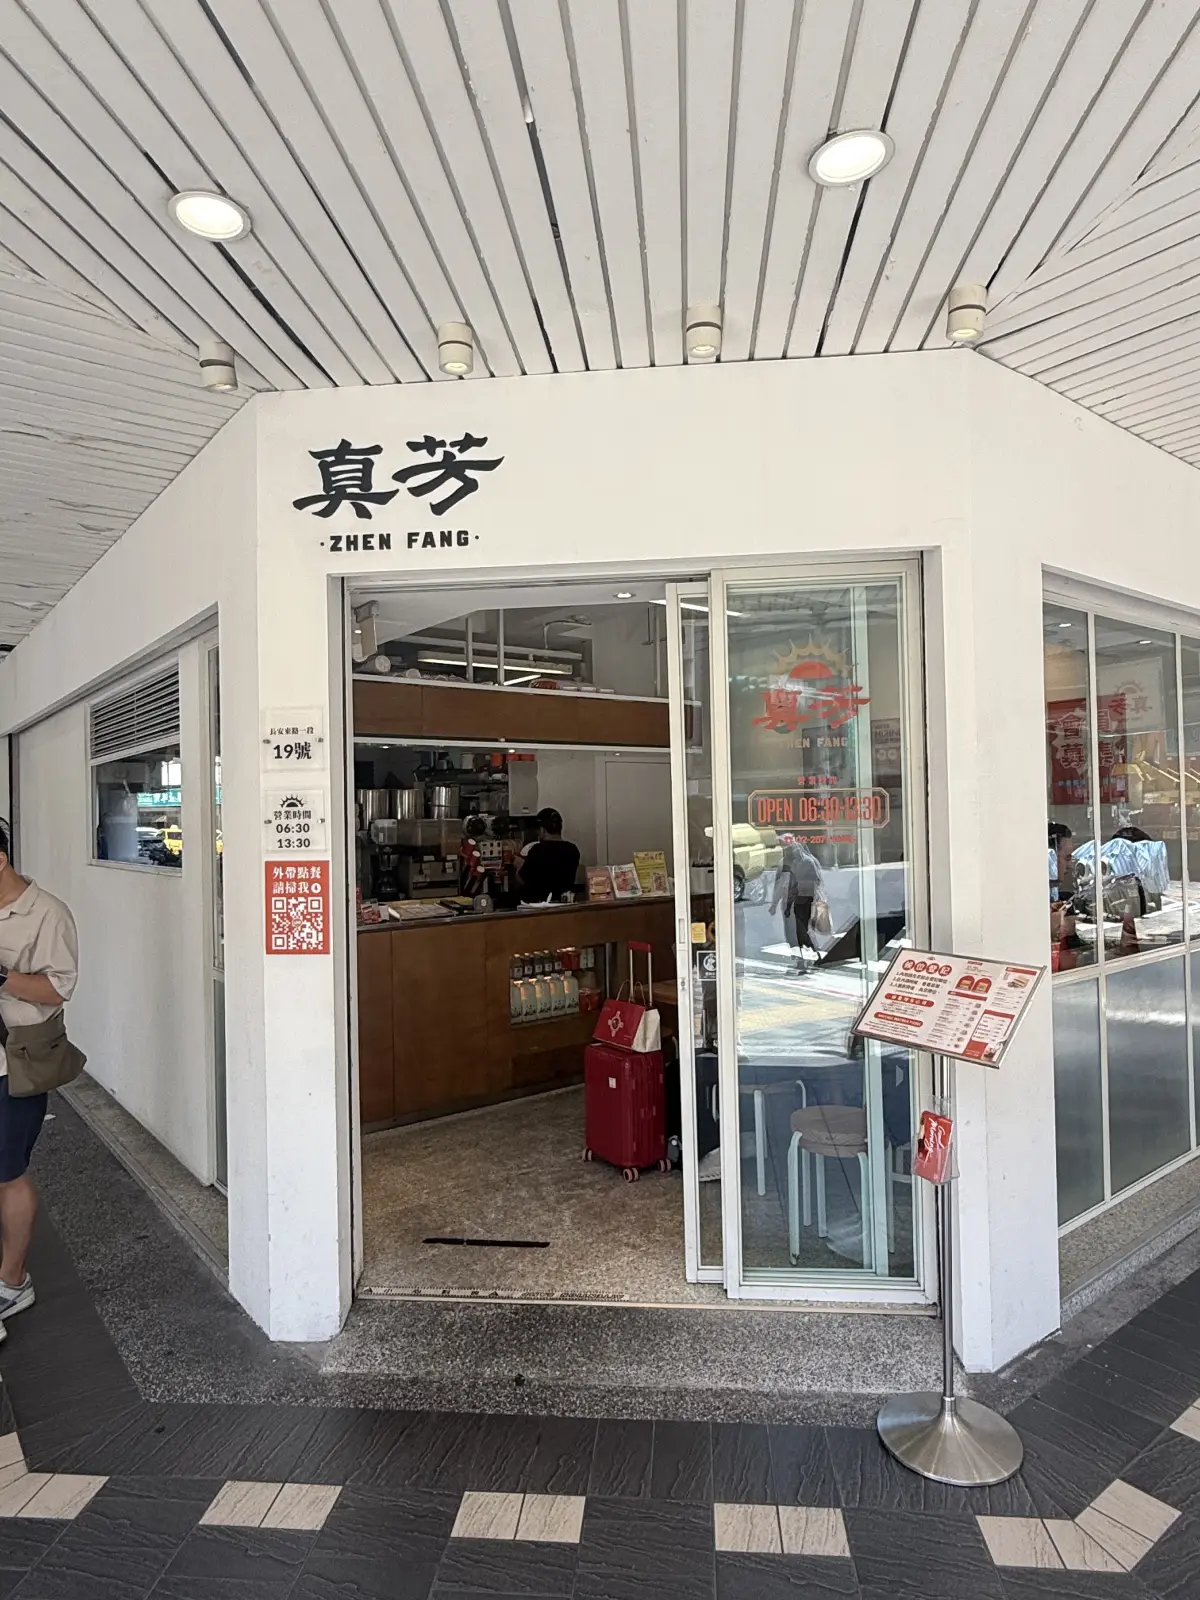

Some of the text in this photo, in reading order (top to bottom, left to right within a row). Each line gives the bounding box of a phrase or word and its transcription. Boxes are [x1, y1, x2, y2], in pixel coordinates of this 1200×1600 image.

[293, 432, 505, 520] 真芳
[329, 530, 469, 552] ZHEN FANG
[269, 726, 314, 736] 長安東路一段
[273, 741, 312, 760] 19號
[273, 809, 312, 821] 營業時間
[757, 797, 793, 823] OPEN
[275, 823, 310, 834] 06:30
[277, 837, 311, 849] 13:30
[273, 866, 321, 880] 外帶點餐
[272, 881, 310, 895] 請掃我
